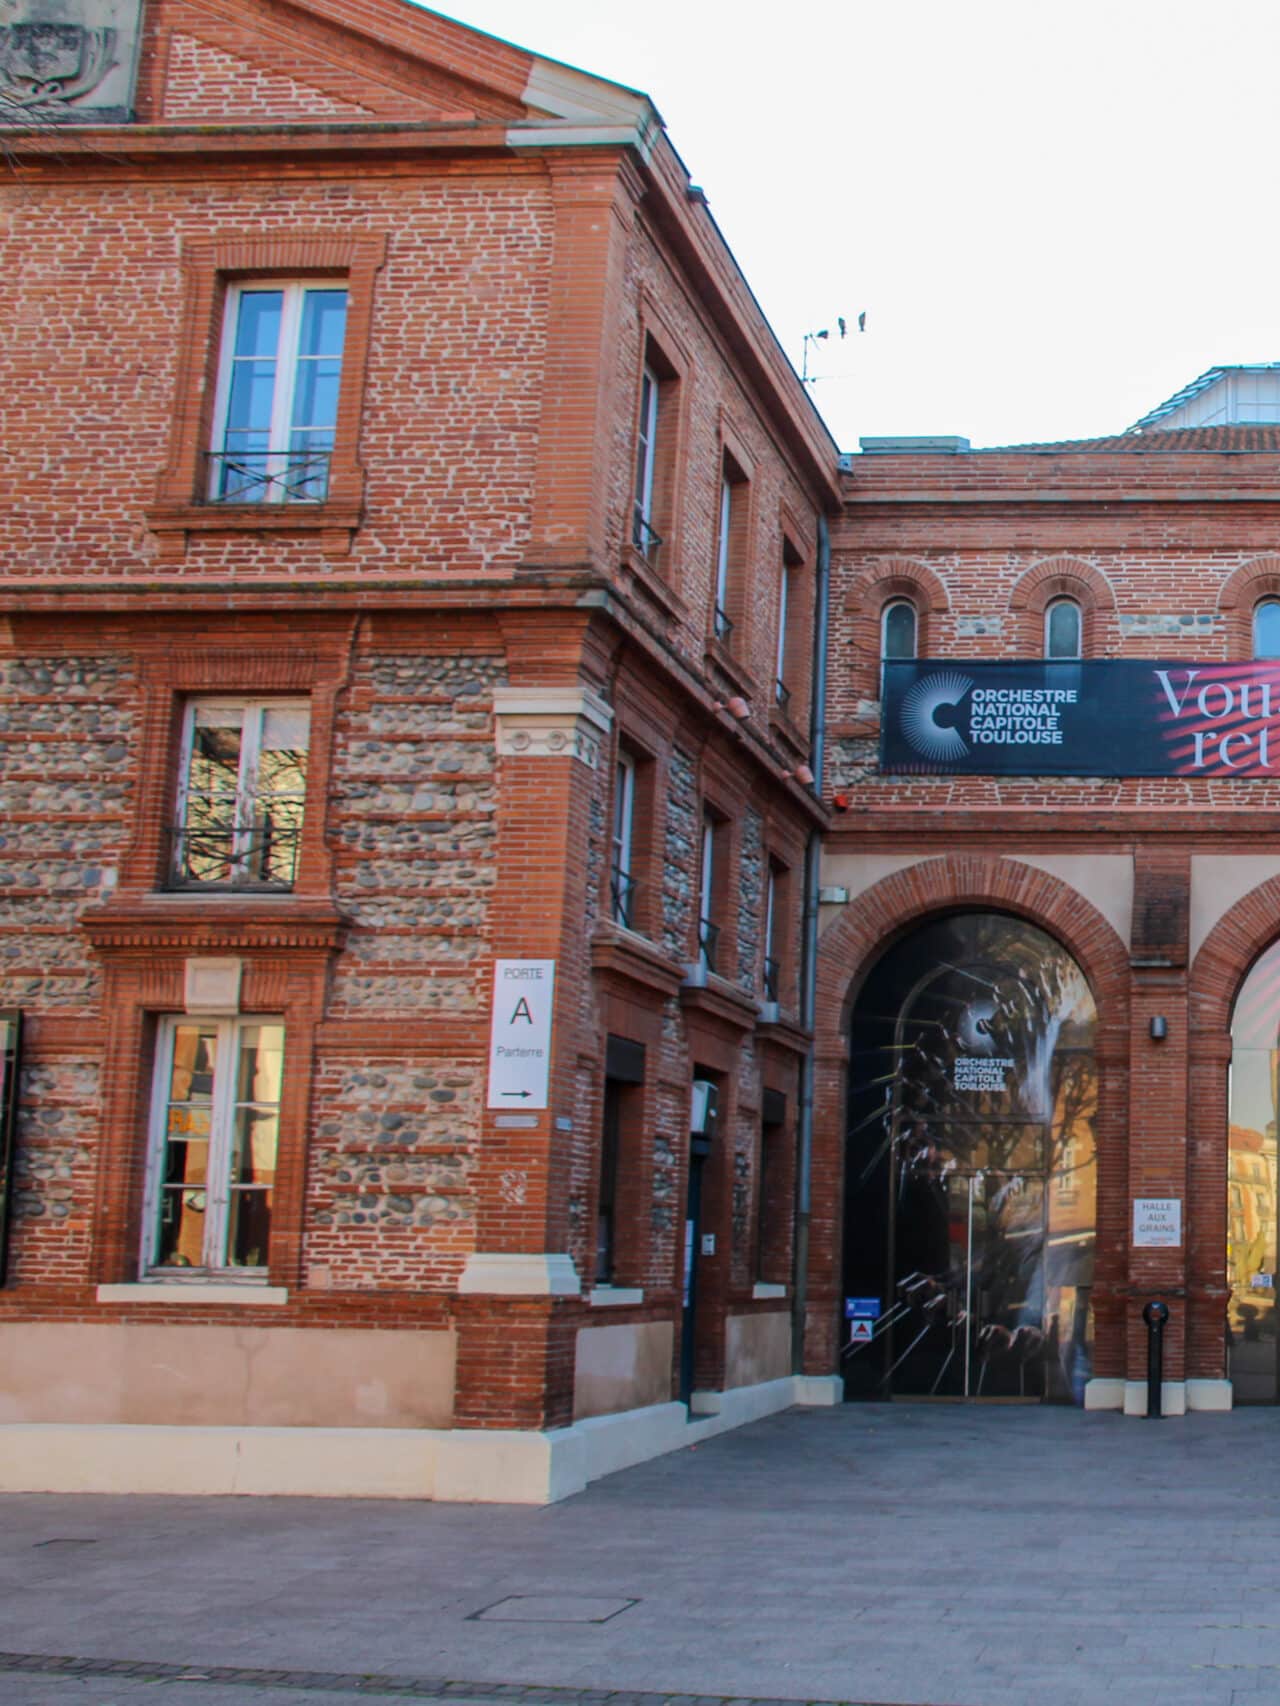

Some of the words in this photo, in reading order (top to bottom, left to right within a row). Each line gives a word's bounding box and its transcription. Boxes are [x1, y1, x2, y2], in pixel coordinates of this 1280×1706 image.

[971, 689, 1077, 703] ORCHESTRE
[971, 703, 1061, 716] NATIONAL
[970, 717, 1057, 730] CAPITOLE
[969, 730, 1063, 744] TOULOUSE
[504, 967, 544, 979] PORTE
[510, 996, 534, 1025] A
[496, 1046, 544, 1058] Parterre
[954, 1058, 1015, 1067] ORCHESTRE
[954, 1066, 1005, 1075] NATIONAL
[954, 1074, 1003, 1083] CAPITOLE
[1142, 1202, 1172, 1211] HALLE
[1147, 1213, 1167, 1222] AUX
[1138, 1224, 1176, 1232] GRAINS
